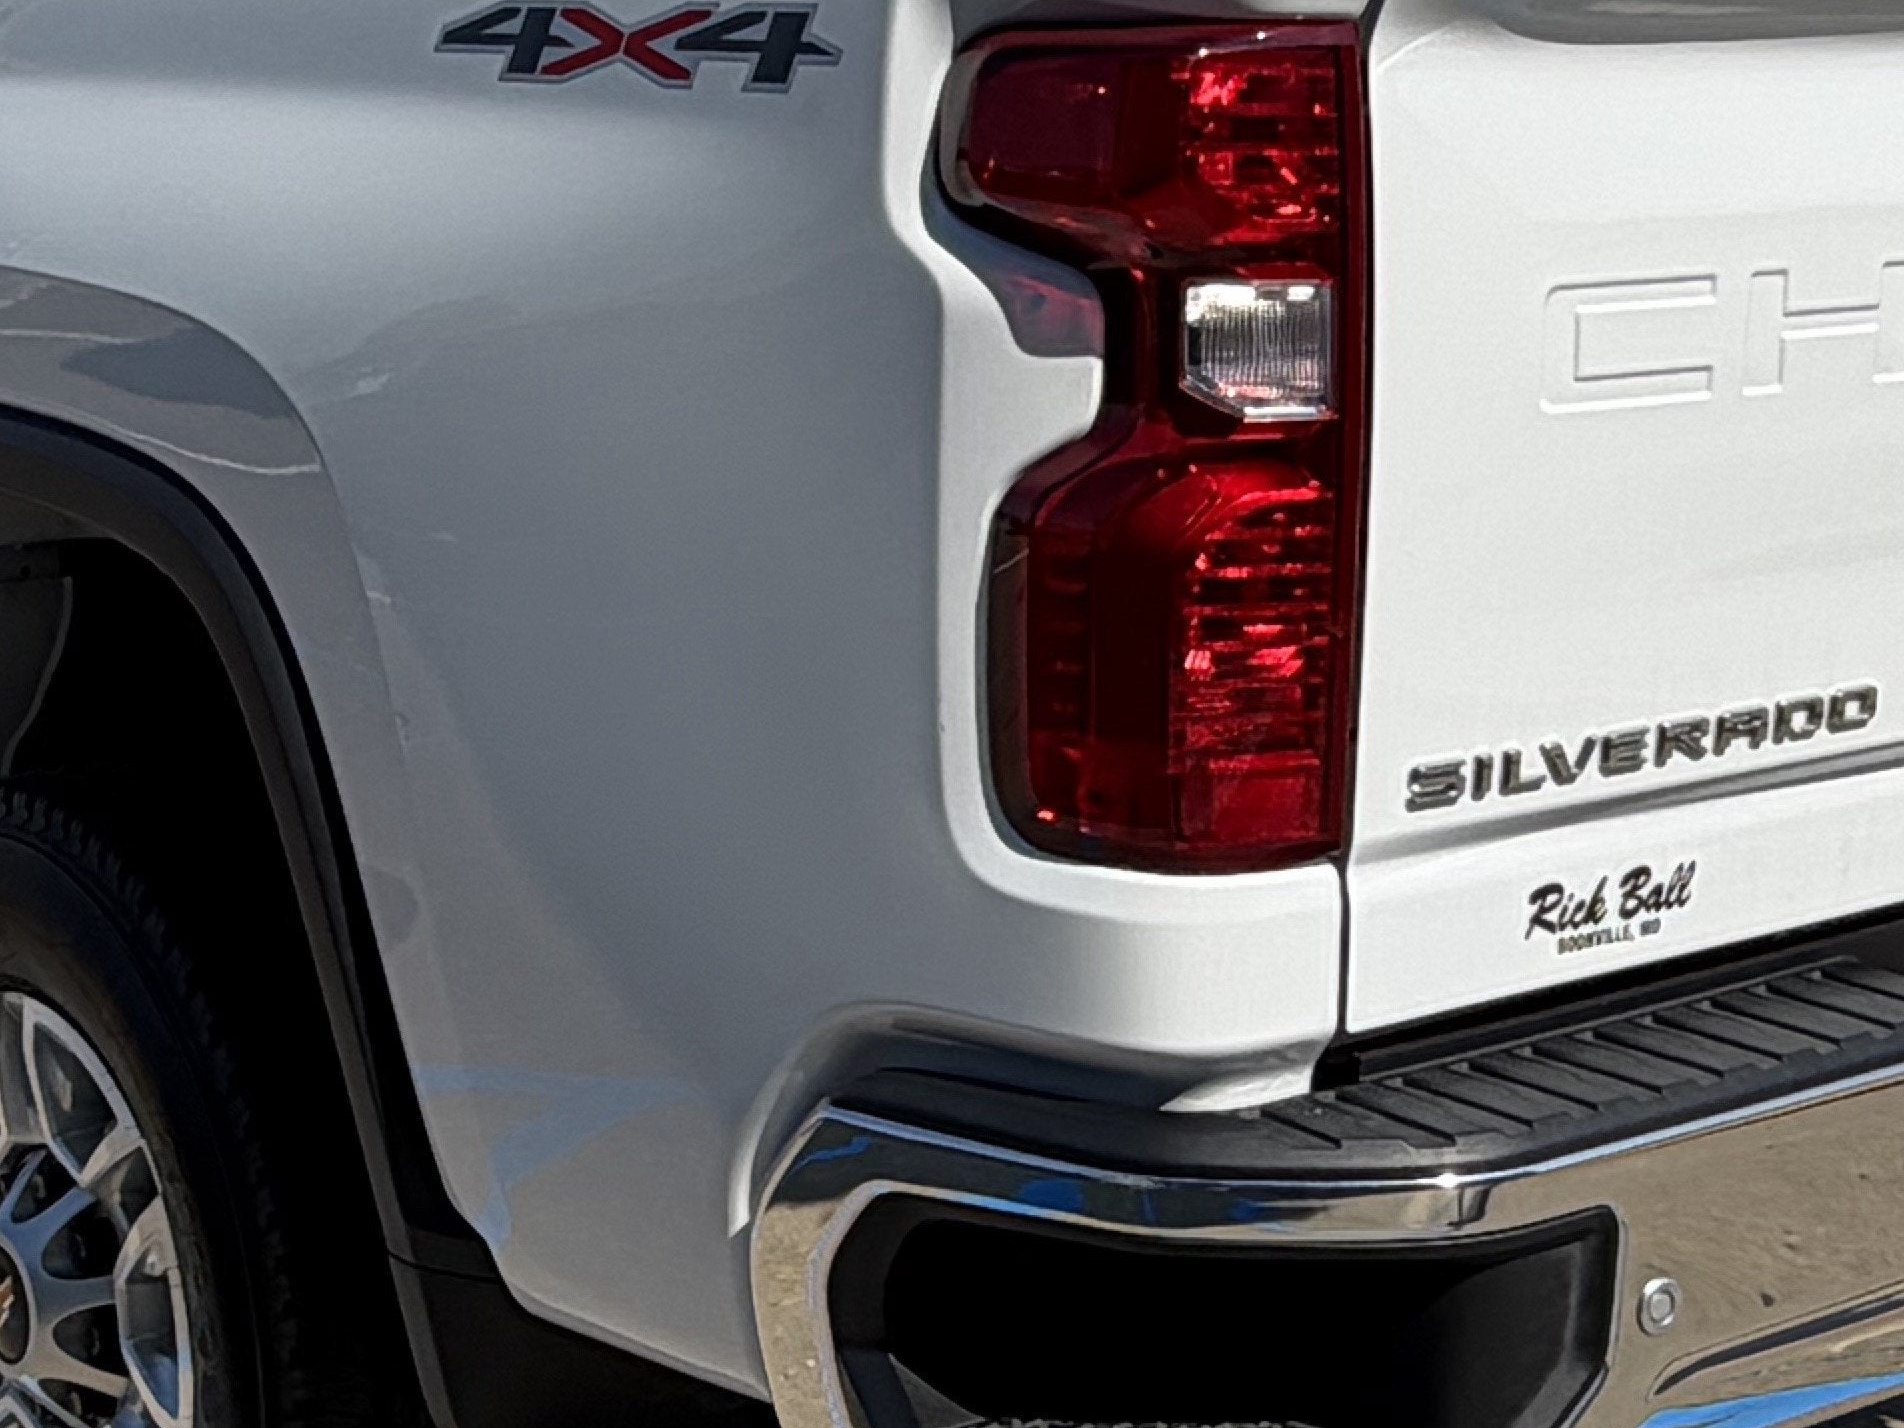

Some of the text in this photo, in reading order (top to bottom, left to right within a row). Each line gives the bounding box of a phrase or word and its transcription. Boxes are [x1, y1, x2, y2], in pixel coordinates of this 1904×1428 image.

[1404, 683, 1879, 814] SILVERADO
[1525, 859, 1696, 941] Rick Ball
